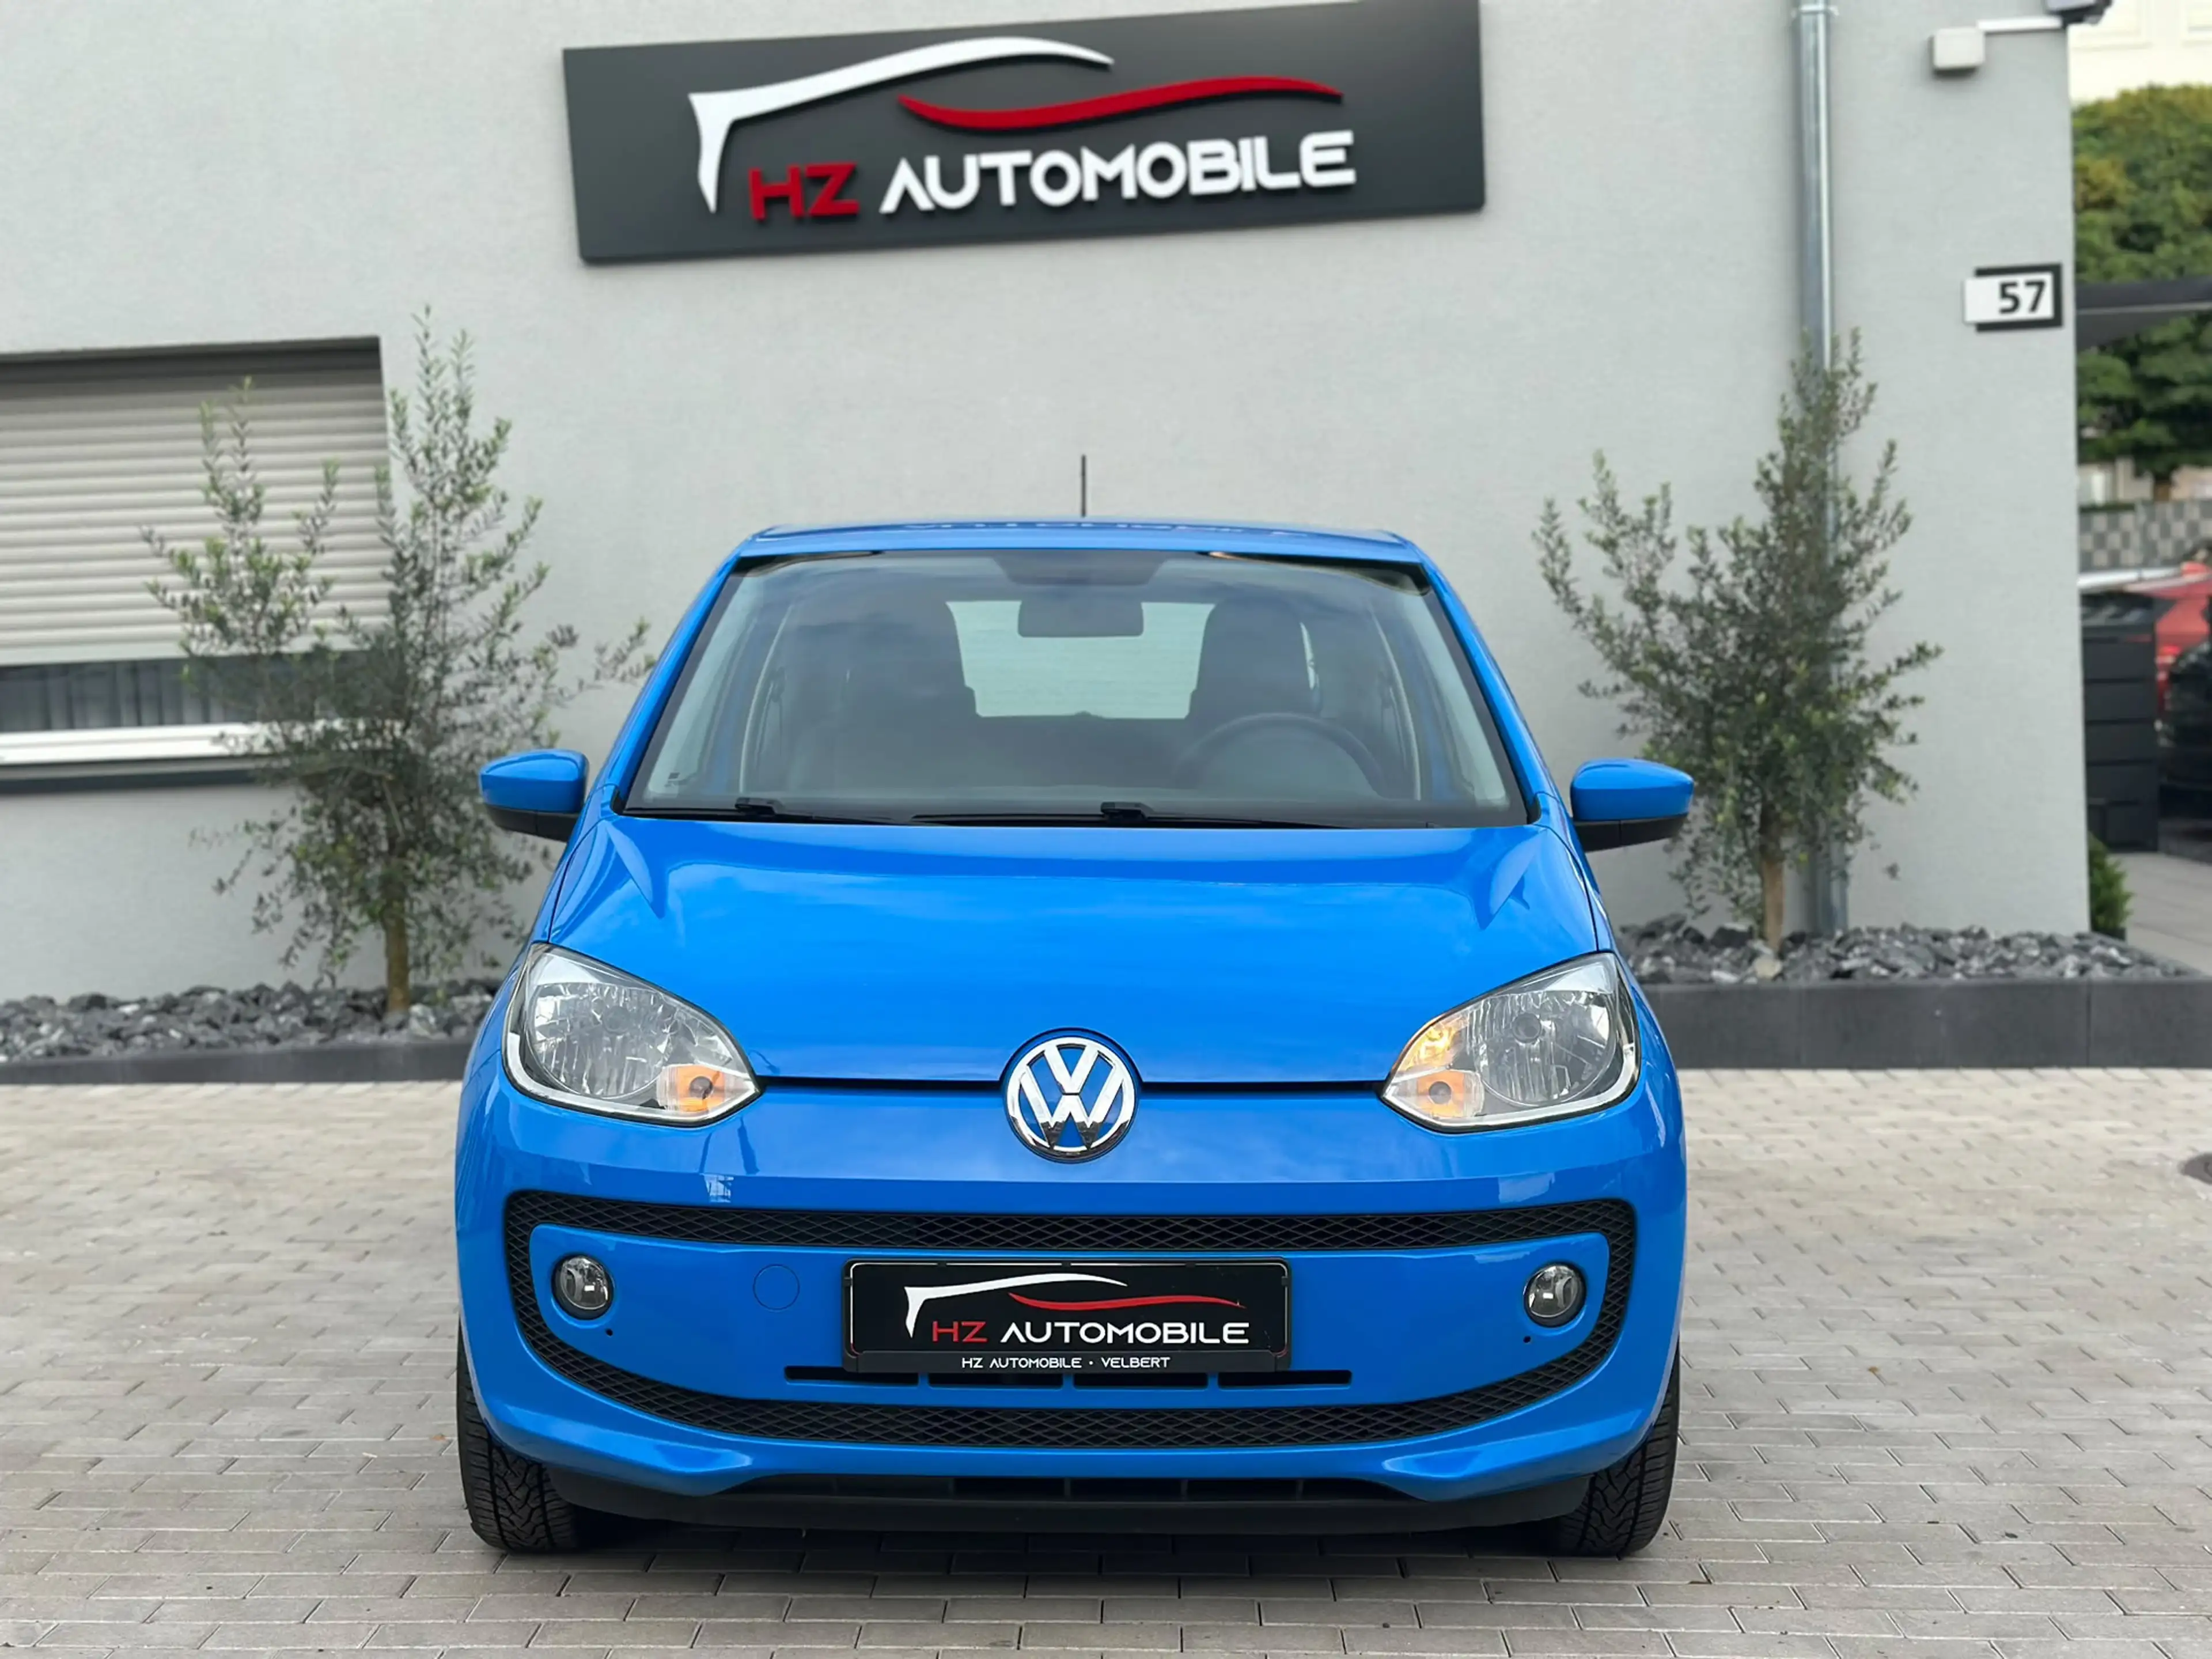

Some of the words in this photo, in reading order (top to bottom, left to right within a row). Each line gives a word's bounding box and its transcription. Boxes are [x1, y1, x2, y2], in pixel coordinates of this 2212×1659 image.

[748, 161, 860, 221] HZ
[880, 130, 1356, 213] AUTOMOBILE
[1999, 279, 2046, 315] 57
[1017, 1041, 1126, 1152] VW
[932, 1320, 988, 1343] HZ
[999, 1321, 1250, 1344] AUTOMOBILE
[961, 1357, 984, 1369] HZ
[988, 1357, 1082, 1369] AUTOMOBILE
[1101, 1356, 1171, 1369] VELBERT
